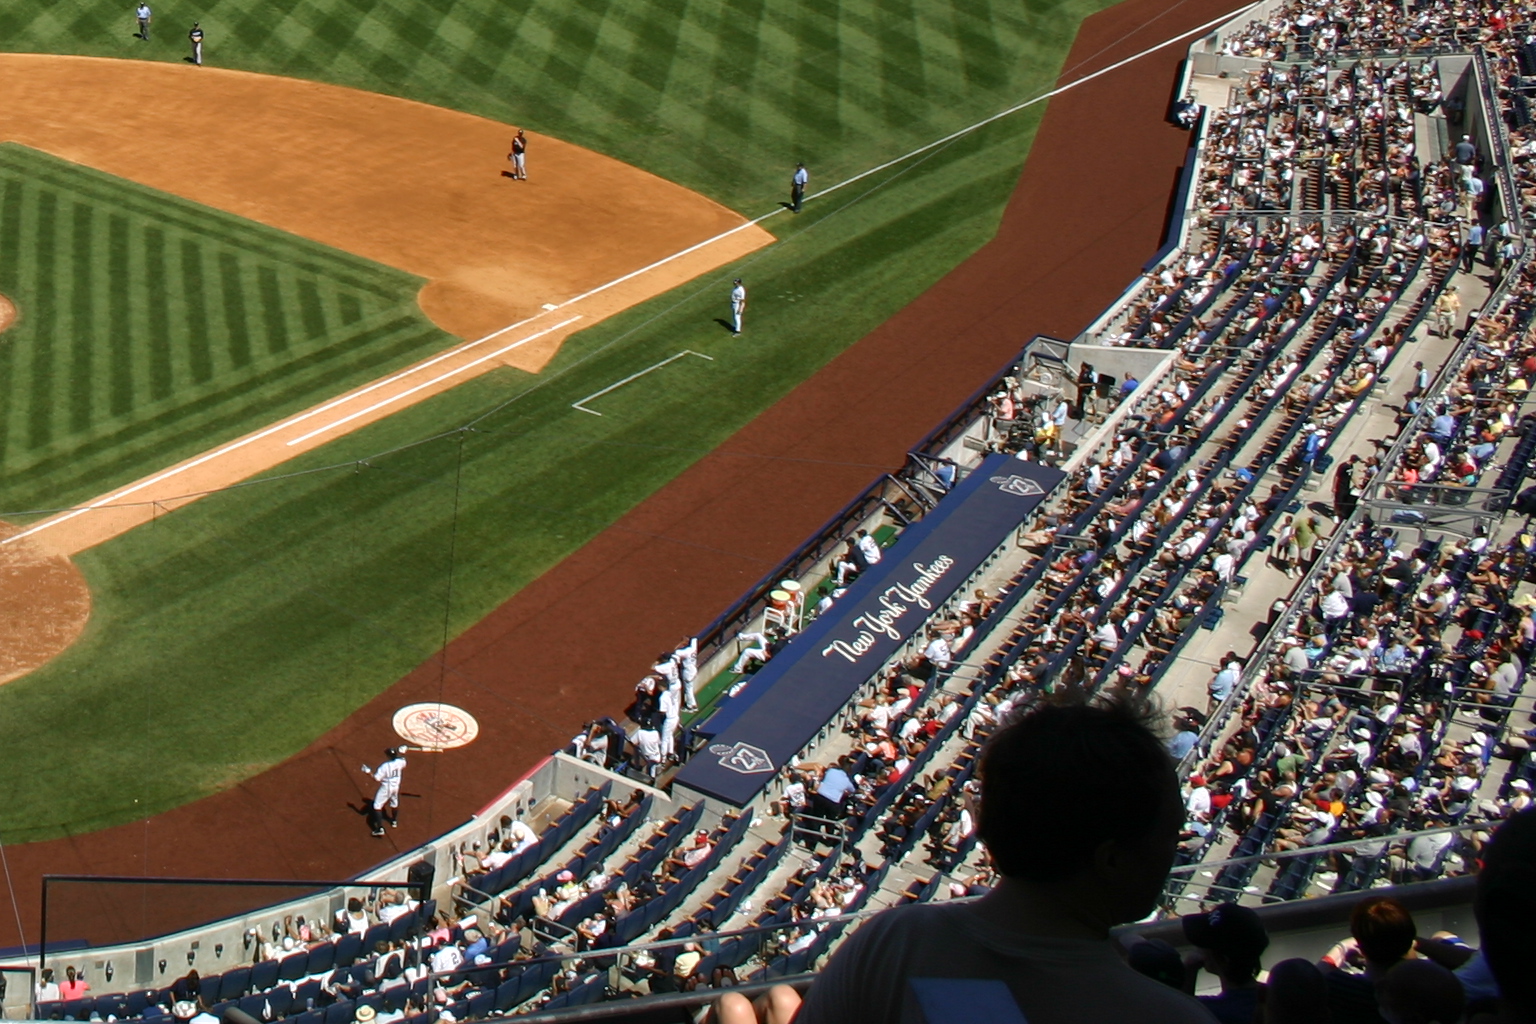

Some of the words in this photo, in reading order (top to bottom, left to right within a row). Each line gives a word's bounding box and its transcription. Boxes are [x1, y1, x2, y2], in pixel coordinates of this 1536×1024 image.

[822, 630, 875, 663] New
[853, 586, 907, 639] York
[898, 553, 954, 610] Yankees
[732, 748, 761, 771] 27
